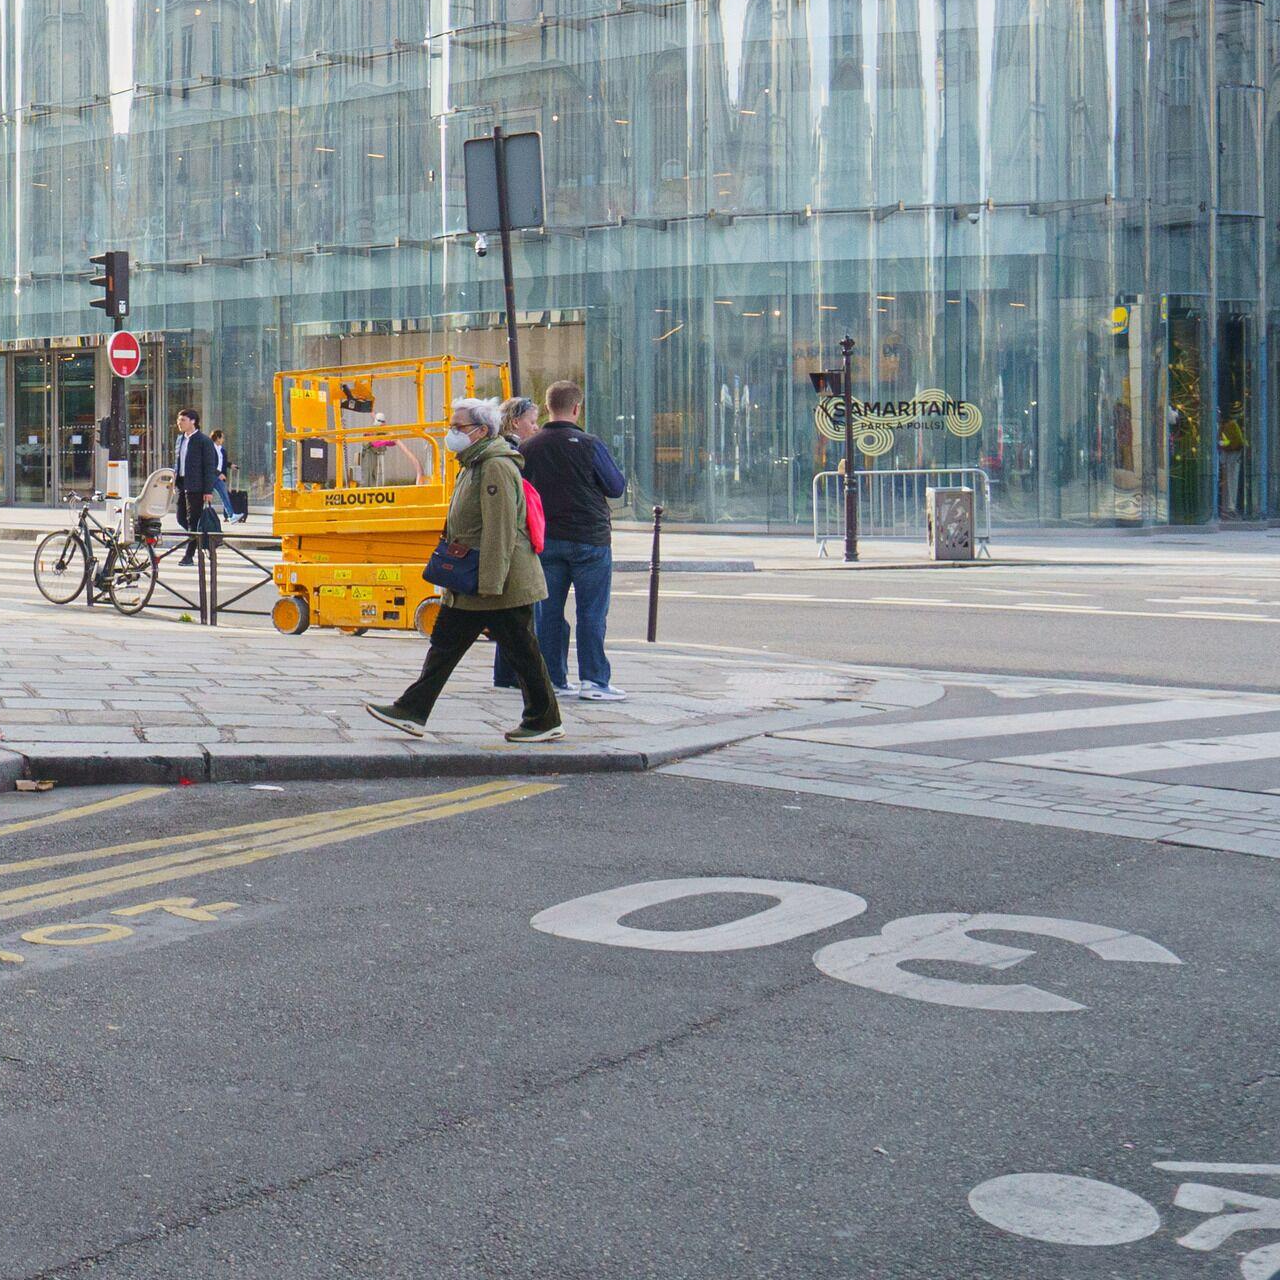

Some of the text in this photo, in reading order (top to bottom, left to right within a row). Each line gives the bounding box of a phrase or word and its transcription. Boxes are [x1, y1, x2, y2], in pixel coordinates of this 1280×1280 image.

[833, 400, 967, 418] SAMARITAINE
[861, 421, 893, 431] PARIS
[529, 876, 1184, 1013] 30
